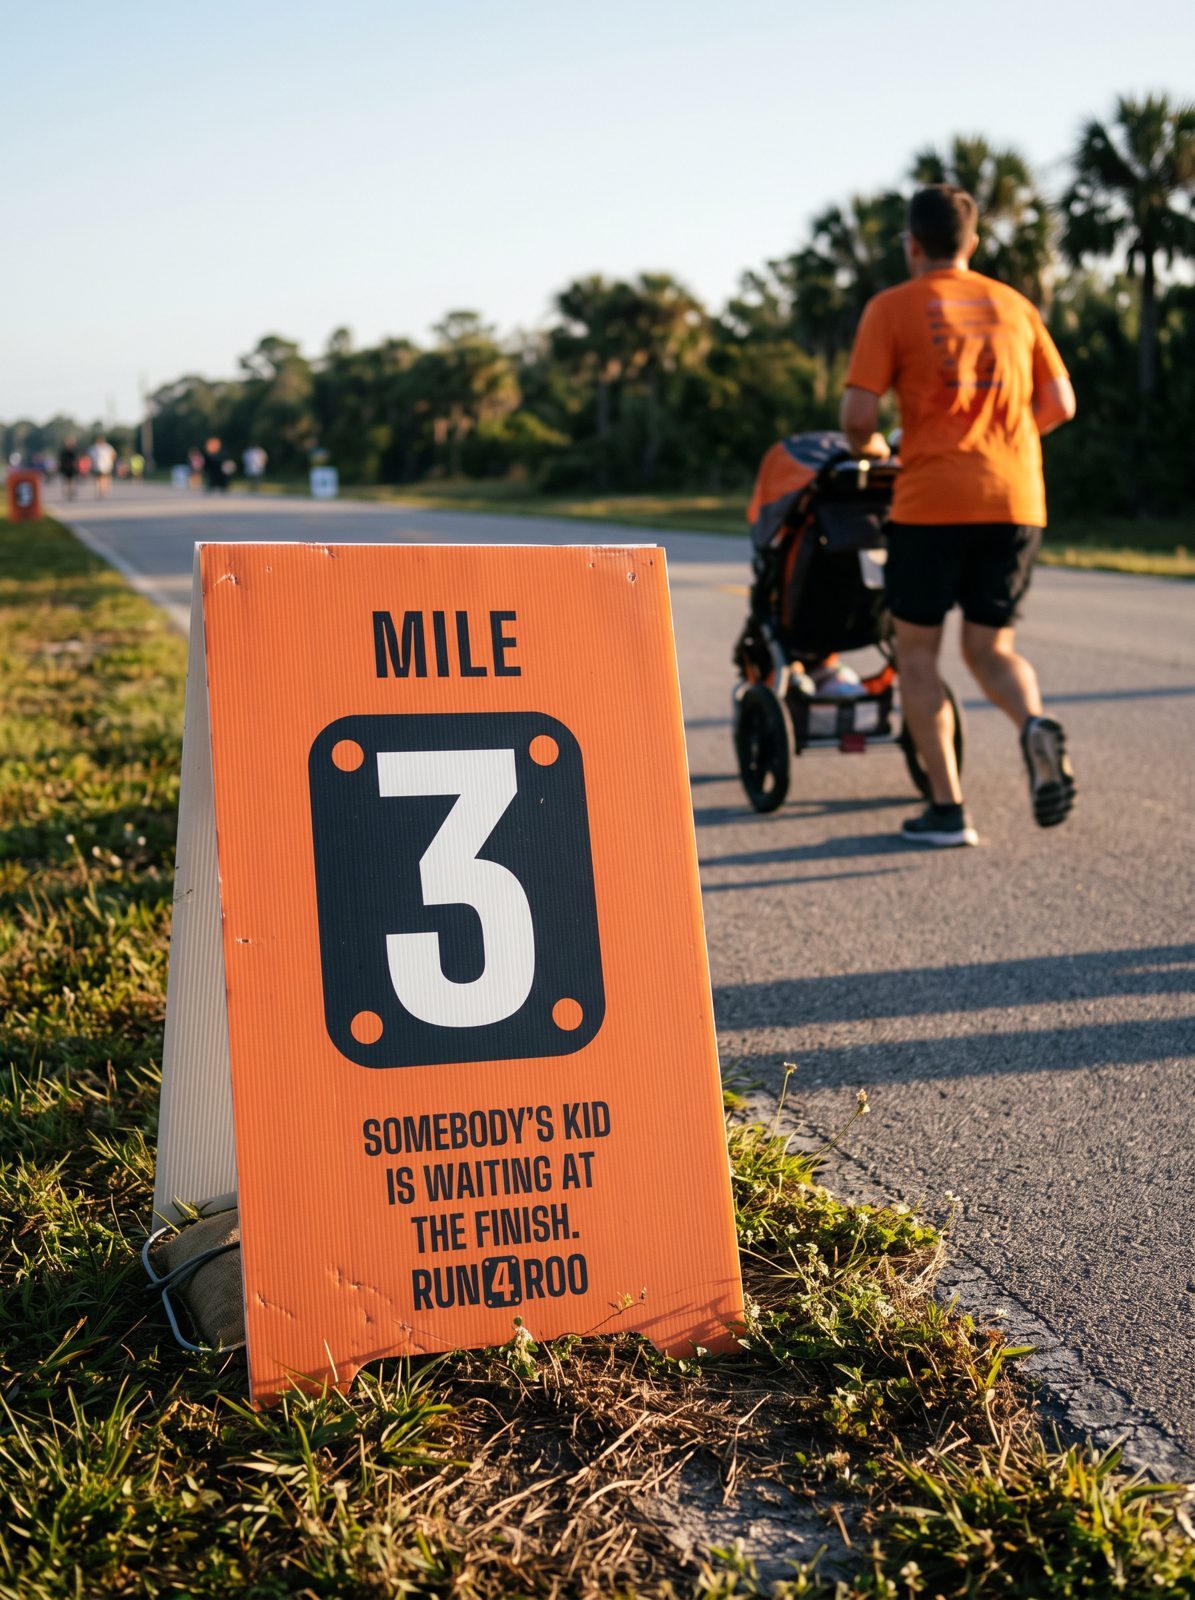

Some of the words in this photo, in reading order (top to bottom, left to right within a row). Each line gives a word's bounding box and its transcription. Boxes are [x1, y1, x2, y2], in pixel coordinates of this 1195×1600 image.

[372, 611, 522, 678] MILE
[376, 748, 536, 1028] 3
[362, 1104, 555, 1157] SOMEBODY’S
[562, 1100, 612, 1140] KID
[386, 1166, 416, 1206] IS
[423, 1155, 553, 1203] WAITING
[562, 1151, 596, 1190] AT
[411, 1212, 467, 1254] THE
[474, 1202, 581, 1249] FINISH.
[411, 1253, 589, 1311] RUN4ROO
